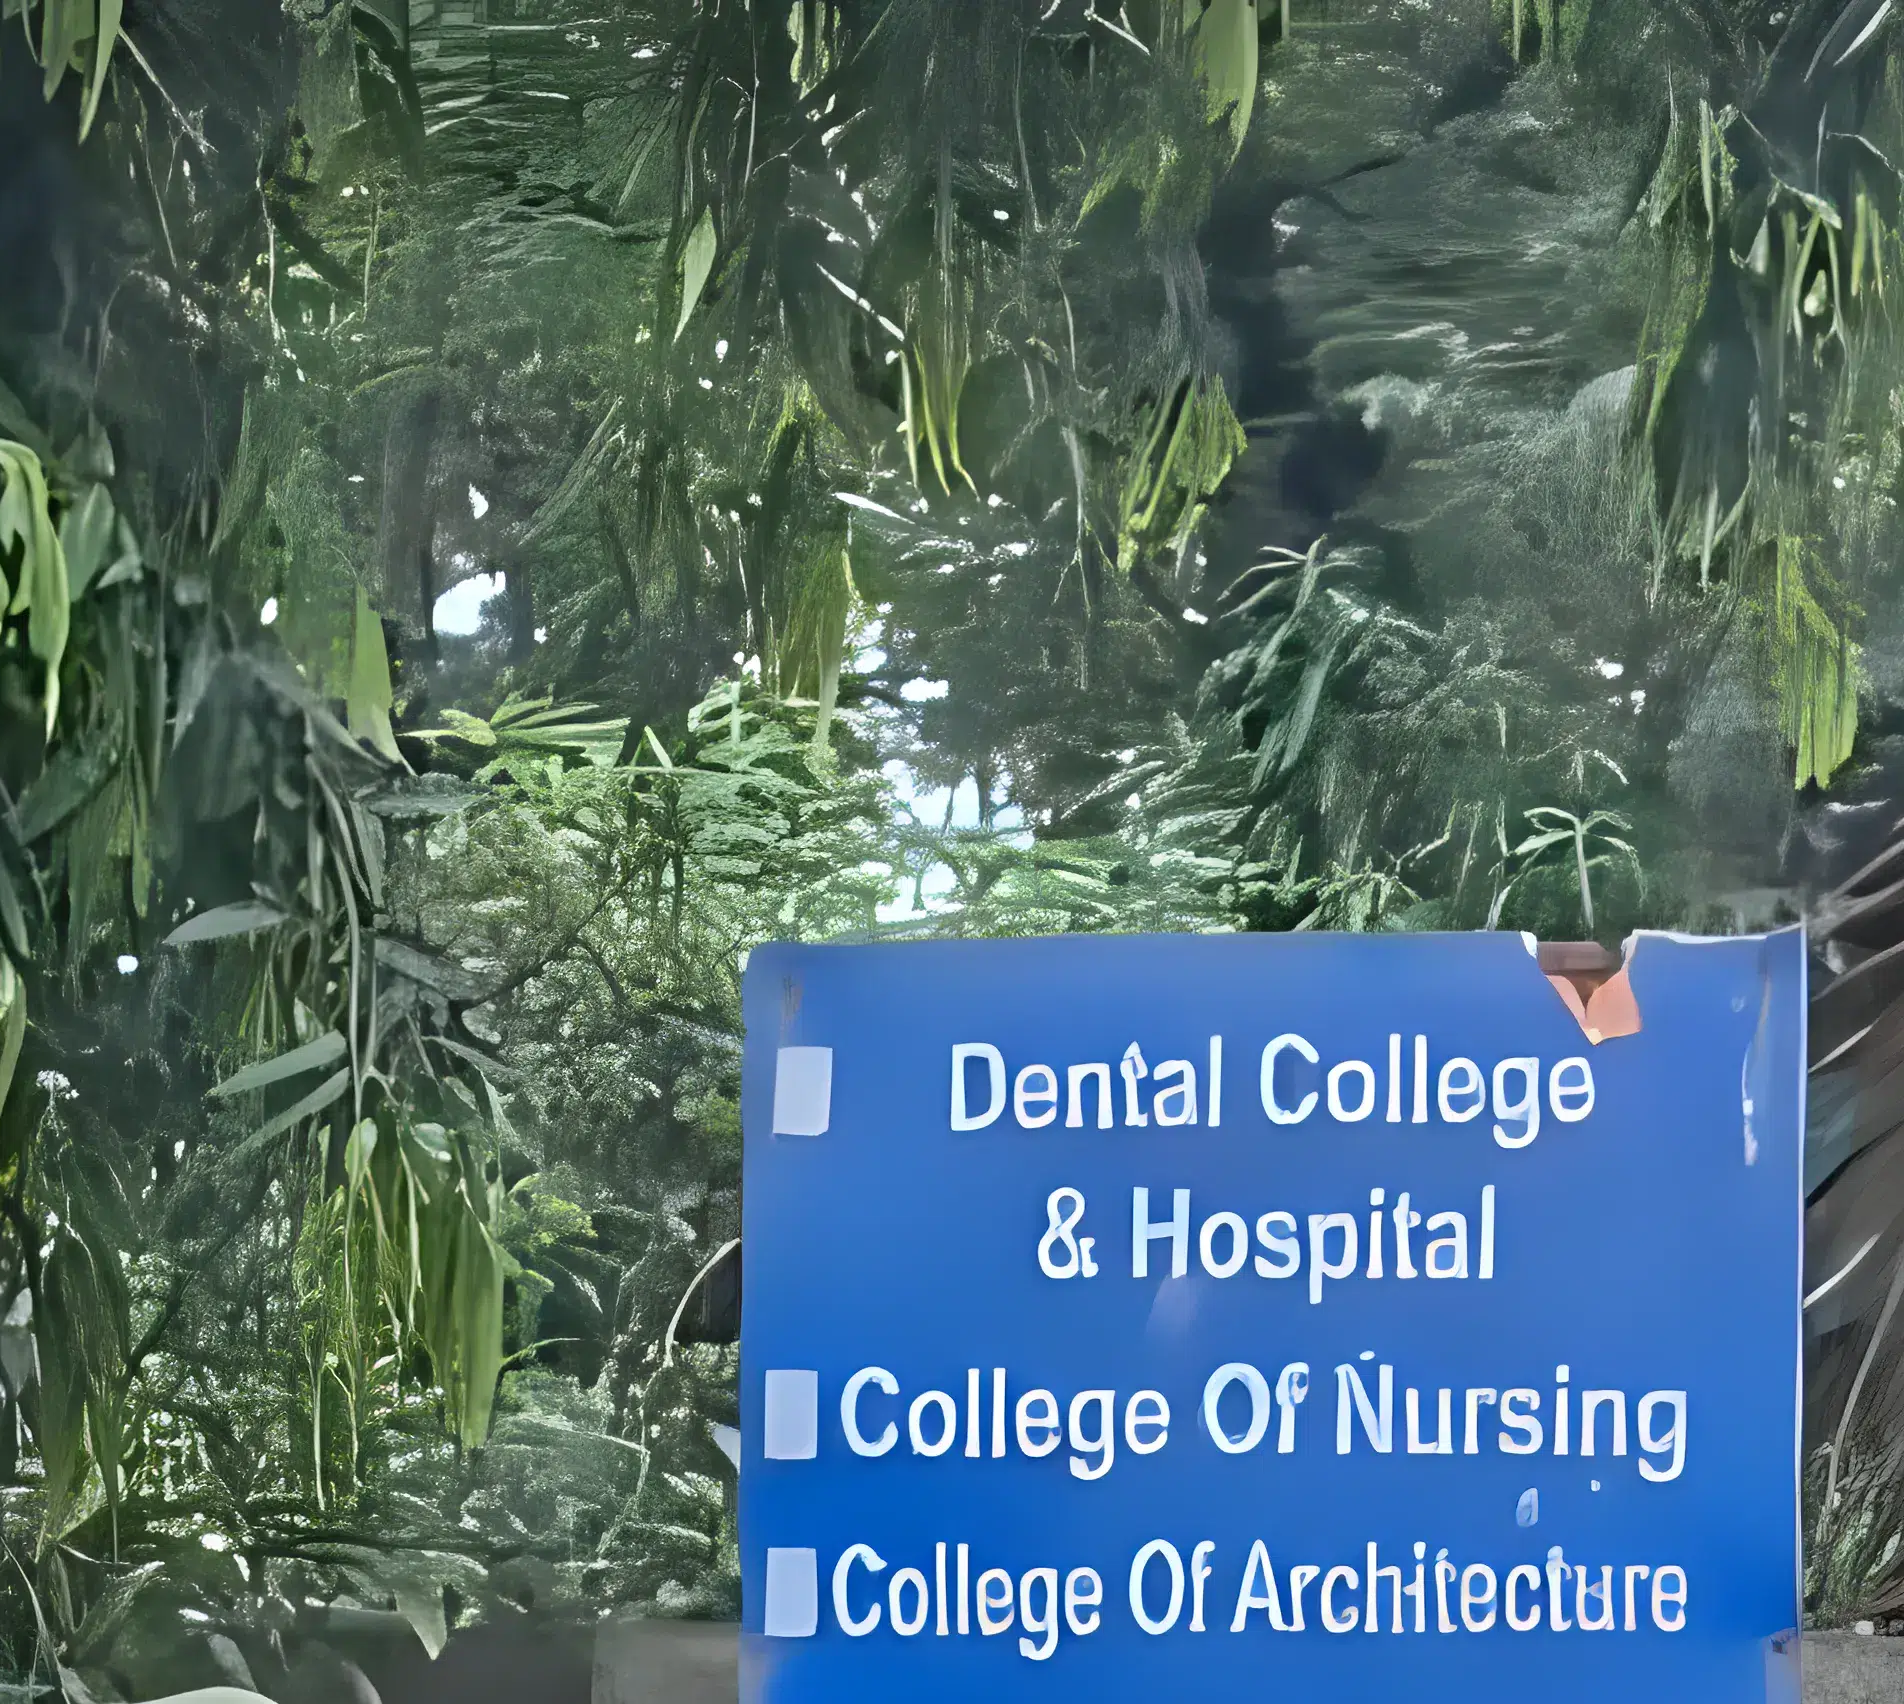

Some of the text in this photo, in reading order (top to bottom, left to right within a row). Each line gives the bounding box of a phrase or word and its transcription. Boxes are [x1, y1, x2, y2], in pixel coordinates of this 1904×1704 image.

[950, 1032, 1596, 1149] Dental College
[1037, 1184, 1496, 1305] & Hospital
[840, 1360, 1687, 1491] College Of Nursing
[832, 1538, 1688, 1661] College Of Architecture
